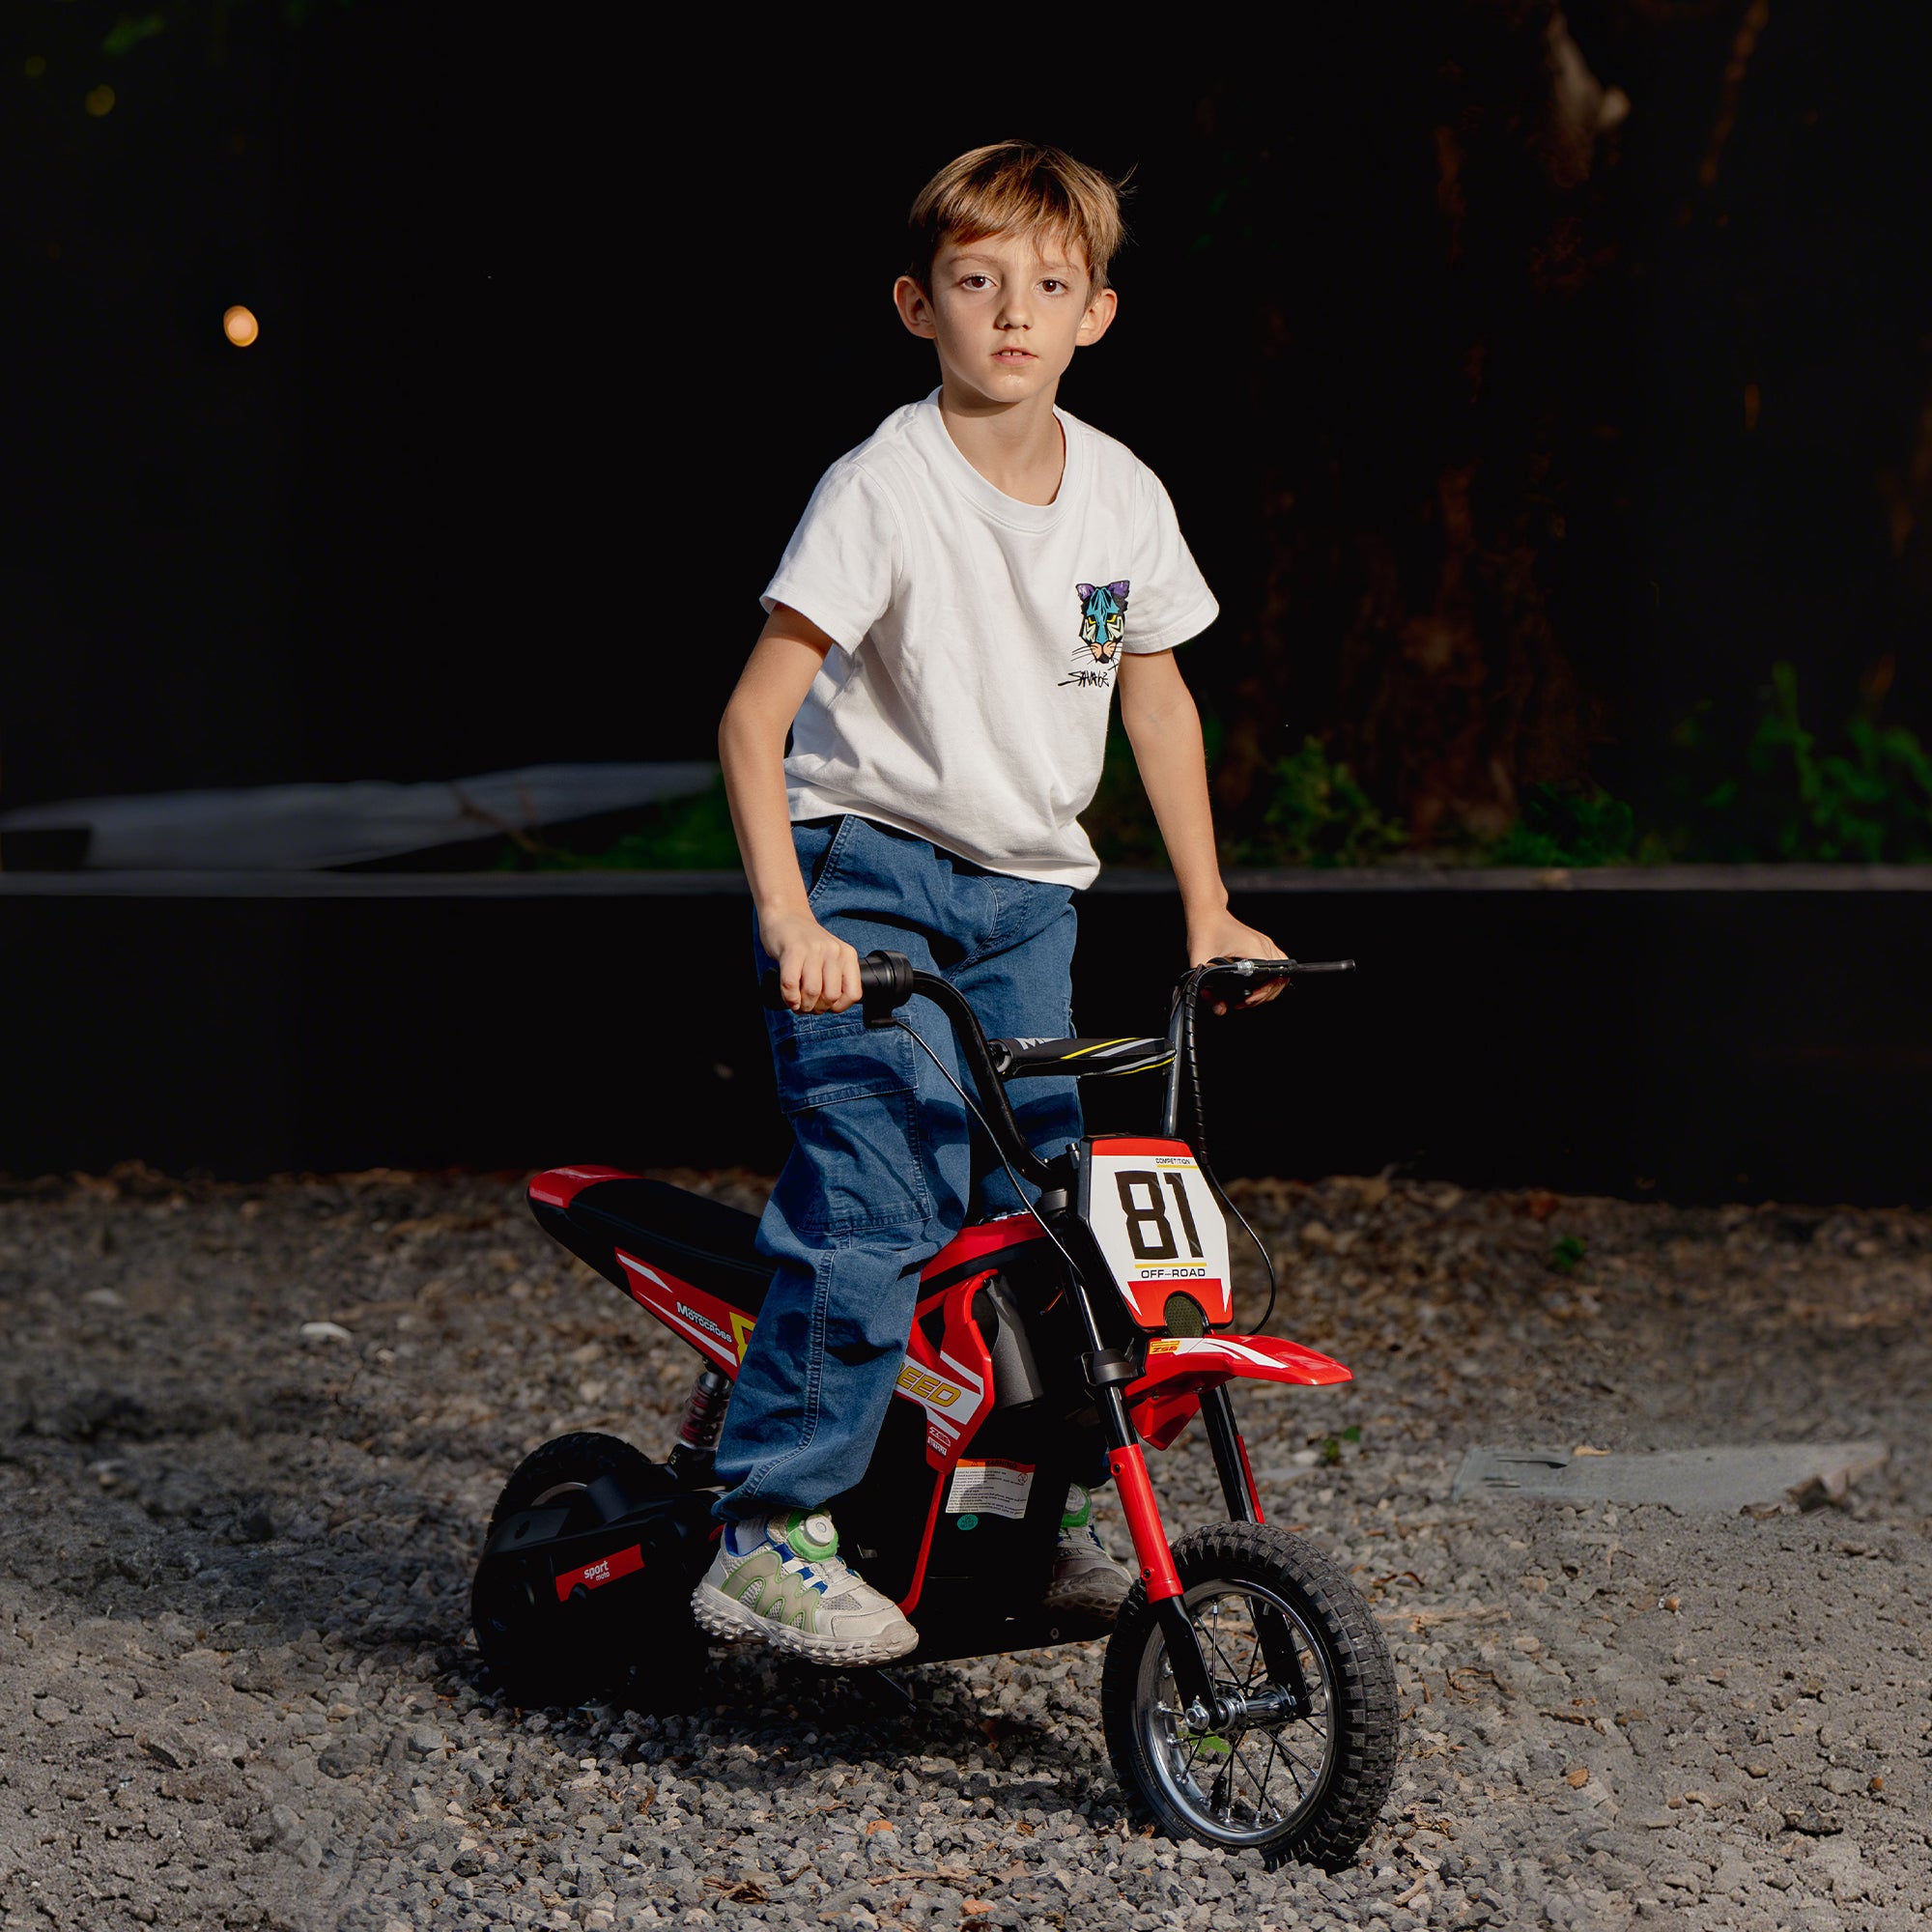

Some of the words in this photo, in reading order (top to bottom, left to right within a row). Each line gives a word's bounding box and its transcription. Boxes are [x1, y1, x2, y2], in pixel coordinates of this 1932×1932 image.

[1114, 1170, 1205, 1260] 81
[1141, 1268, 1206, 1279] OFF-ROAD
[896, 1362, 961, 1407] EED
[583, 1560, 610, 1580] sport
